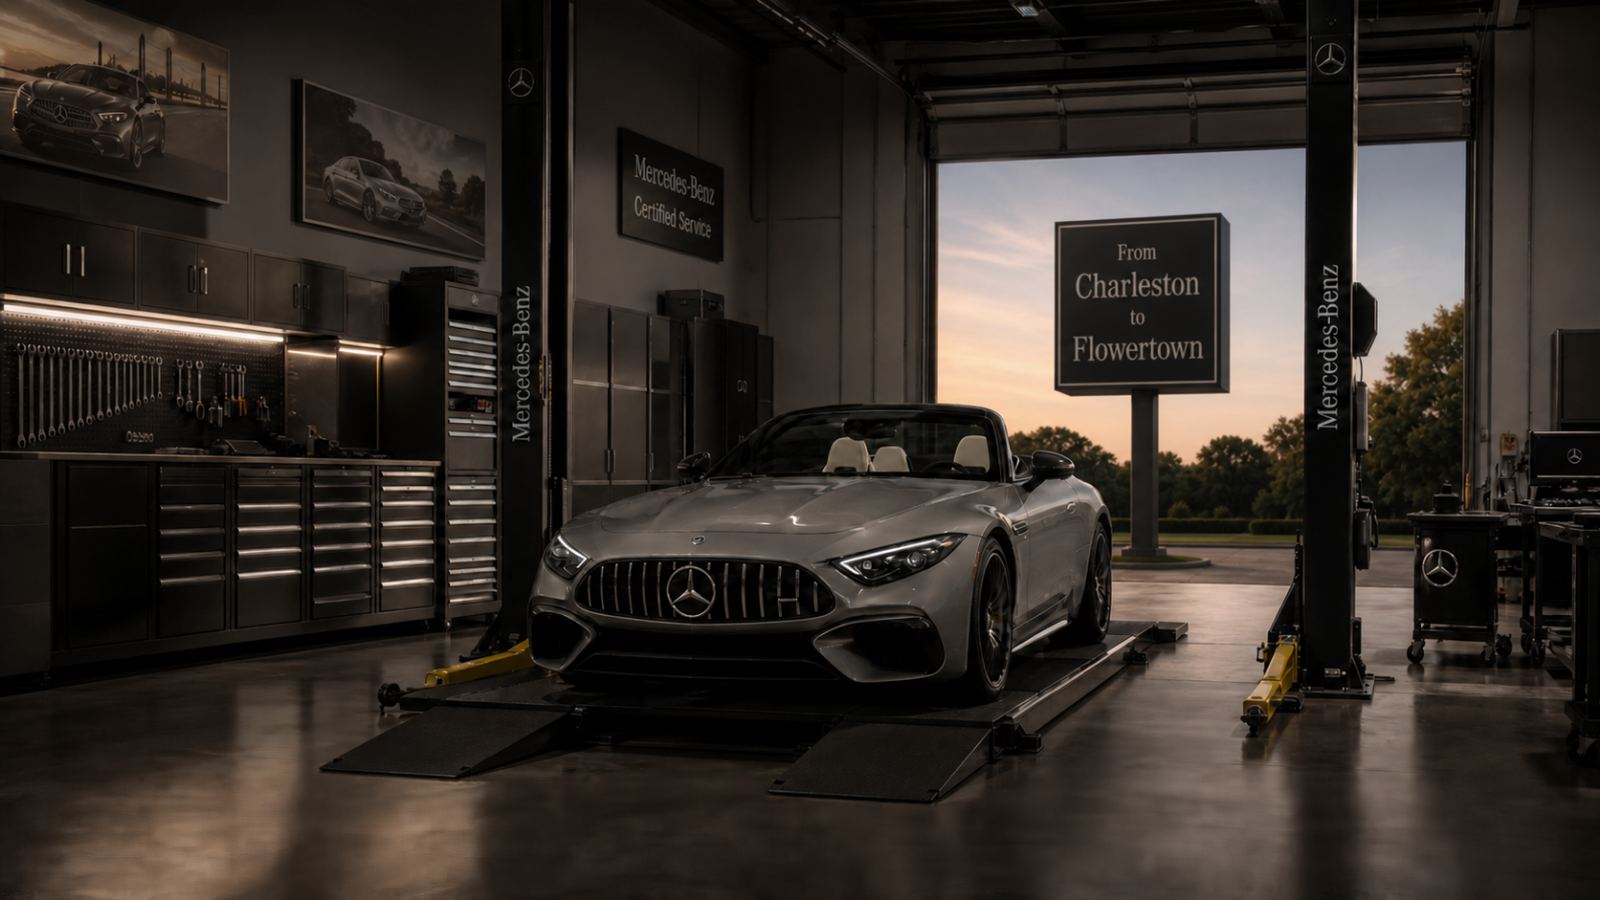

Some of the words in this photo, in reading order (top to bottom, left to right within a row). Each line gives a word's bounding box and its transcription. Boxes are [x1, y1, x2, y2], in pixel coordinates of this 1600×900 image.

[634, 154, 716, 206] Mercedes-Benz
[634, 195, 677, 228] Certified
[678, 211, 712, 239] Service
[1117, 243, 1157, 261] From
[1075, 271, 1200, 300] Charleston
[1129, 309, 1146, 326] to
[512, 285, 531, 443] Mercedes-Benz
[1072, 335, 1204, 363] Flowertown
[1317, 264, 1339, 431] Mercedes-Benz
